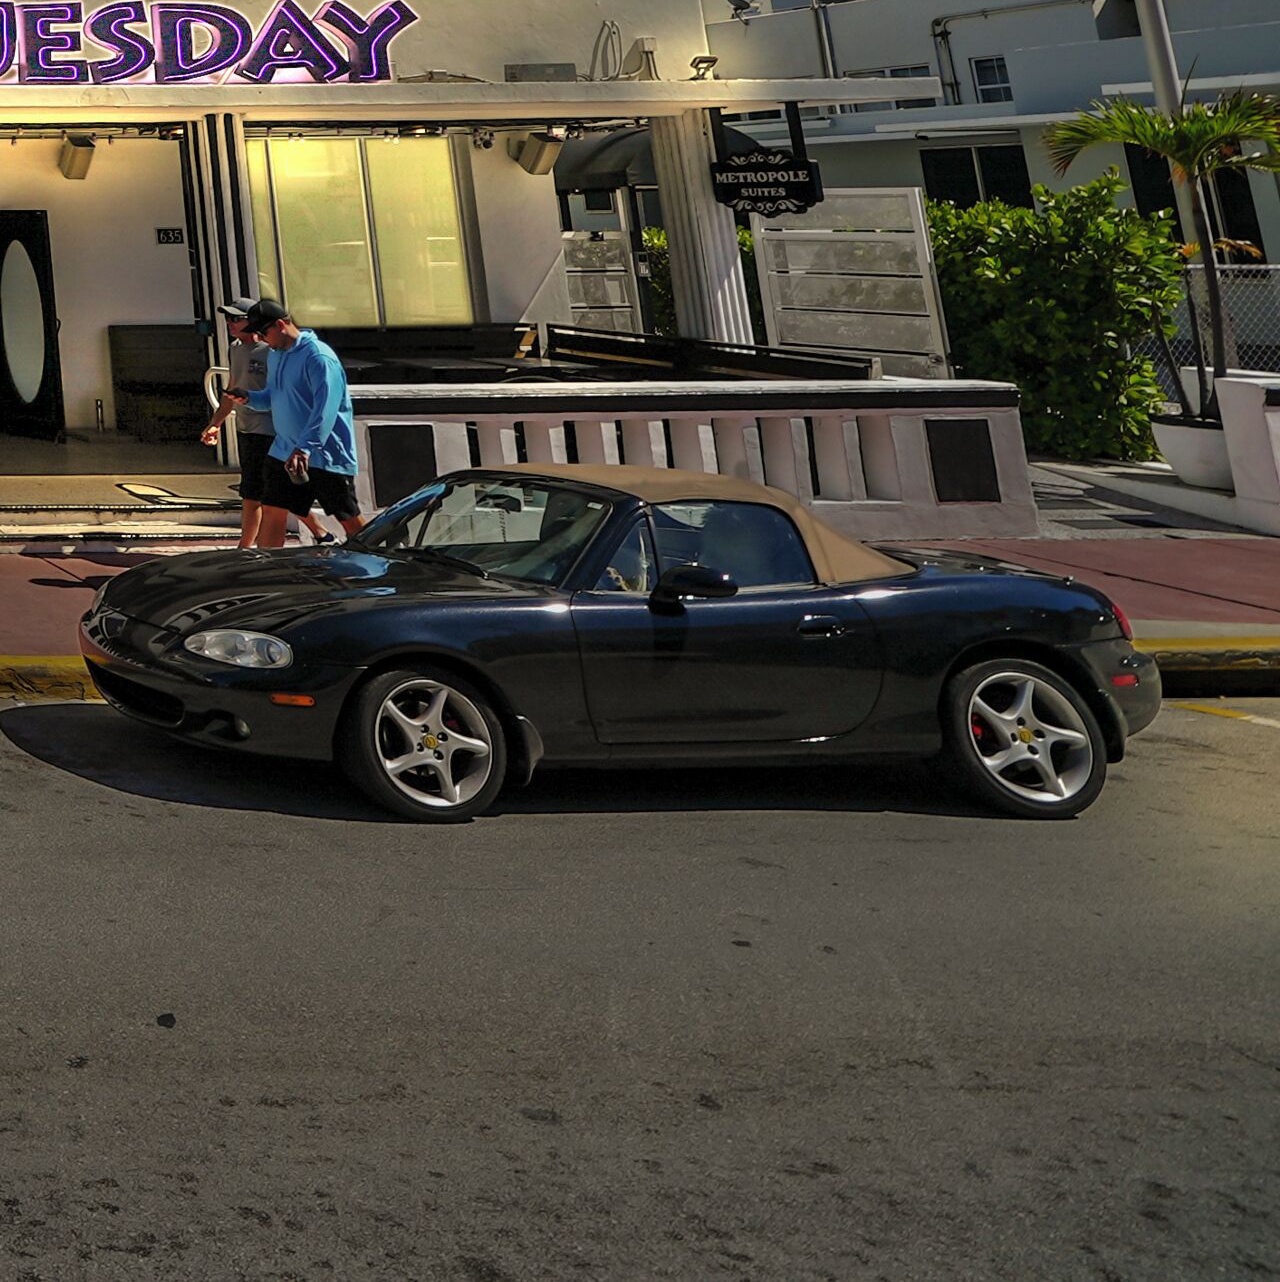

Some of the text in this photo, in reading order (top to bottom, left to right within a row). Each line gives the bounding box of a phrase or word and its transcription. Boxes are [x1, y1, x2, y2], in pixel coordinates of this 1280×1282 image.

[715, 170, 810, 184] METROPOLE
[740, 187, 787, 197] SUITES
[160, 230, 182, 243] 635
